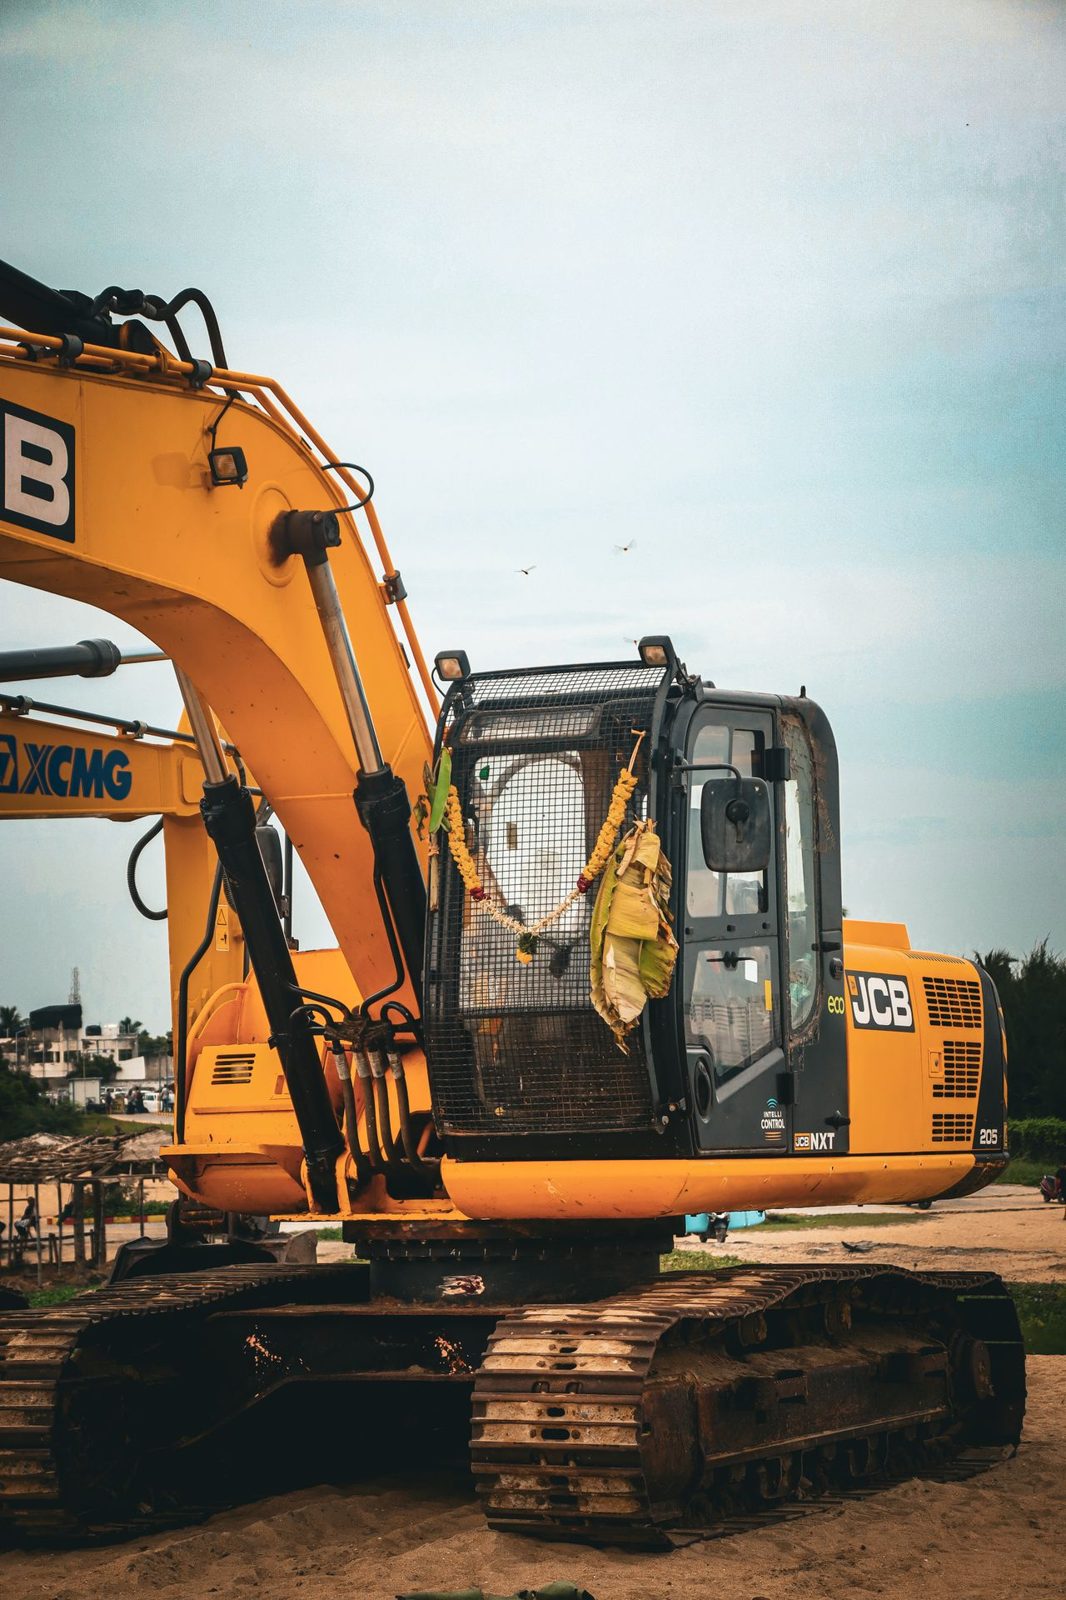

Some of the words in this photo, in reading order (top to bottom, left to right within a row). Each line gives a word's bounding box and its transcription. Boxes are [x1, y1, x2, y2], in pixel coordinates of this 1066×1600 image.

[19, 743, 132, 800] XCMG
[828, 995, 845, 1015] eco
[852, 976, 912, 1027] JCB
[760, 1119, 785, 1129] CONTROL
[795, 1137, 810, 1147] JCB
[810, 1133, 835, 1150] NXT
[980, 1129, 998, 1145] 205
